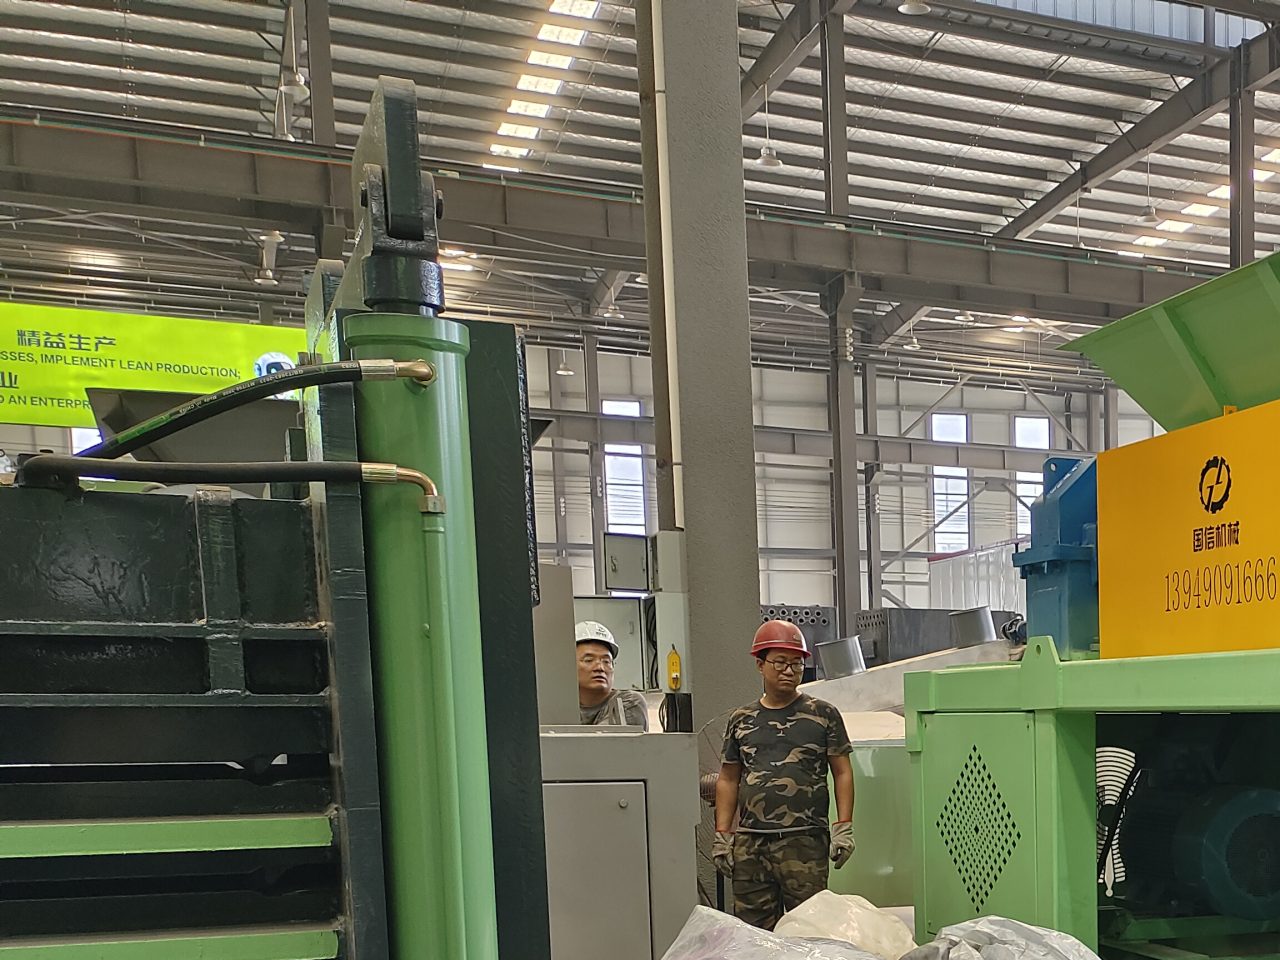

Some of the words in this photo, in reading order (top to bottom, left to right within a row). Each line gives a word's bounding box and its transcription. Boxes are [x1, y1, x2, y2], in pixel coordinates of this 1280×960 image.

[16, 329, 116, 351] 精益生产
[40, 353, 116, 368] IMPLEMENT
[119, 360, 153, 371] LEAN
[156, 362, 240, 379] PRODUCTION;
[9, 394, 27, 405] AN
[1193, 521, 1240, 552] 国信机械
[1164, 556, 1277, 612] 13949091666
